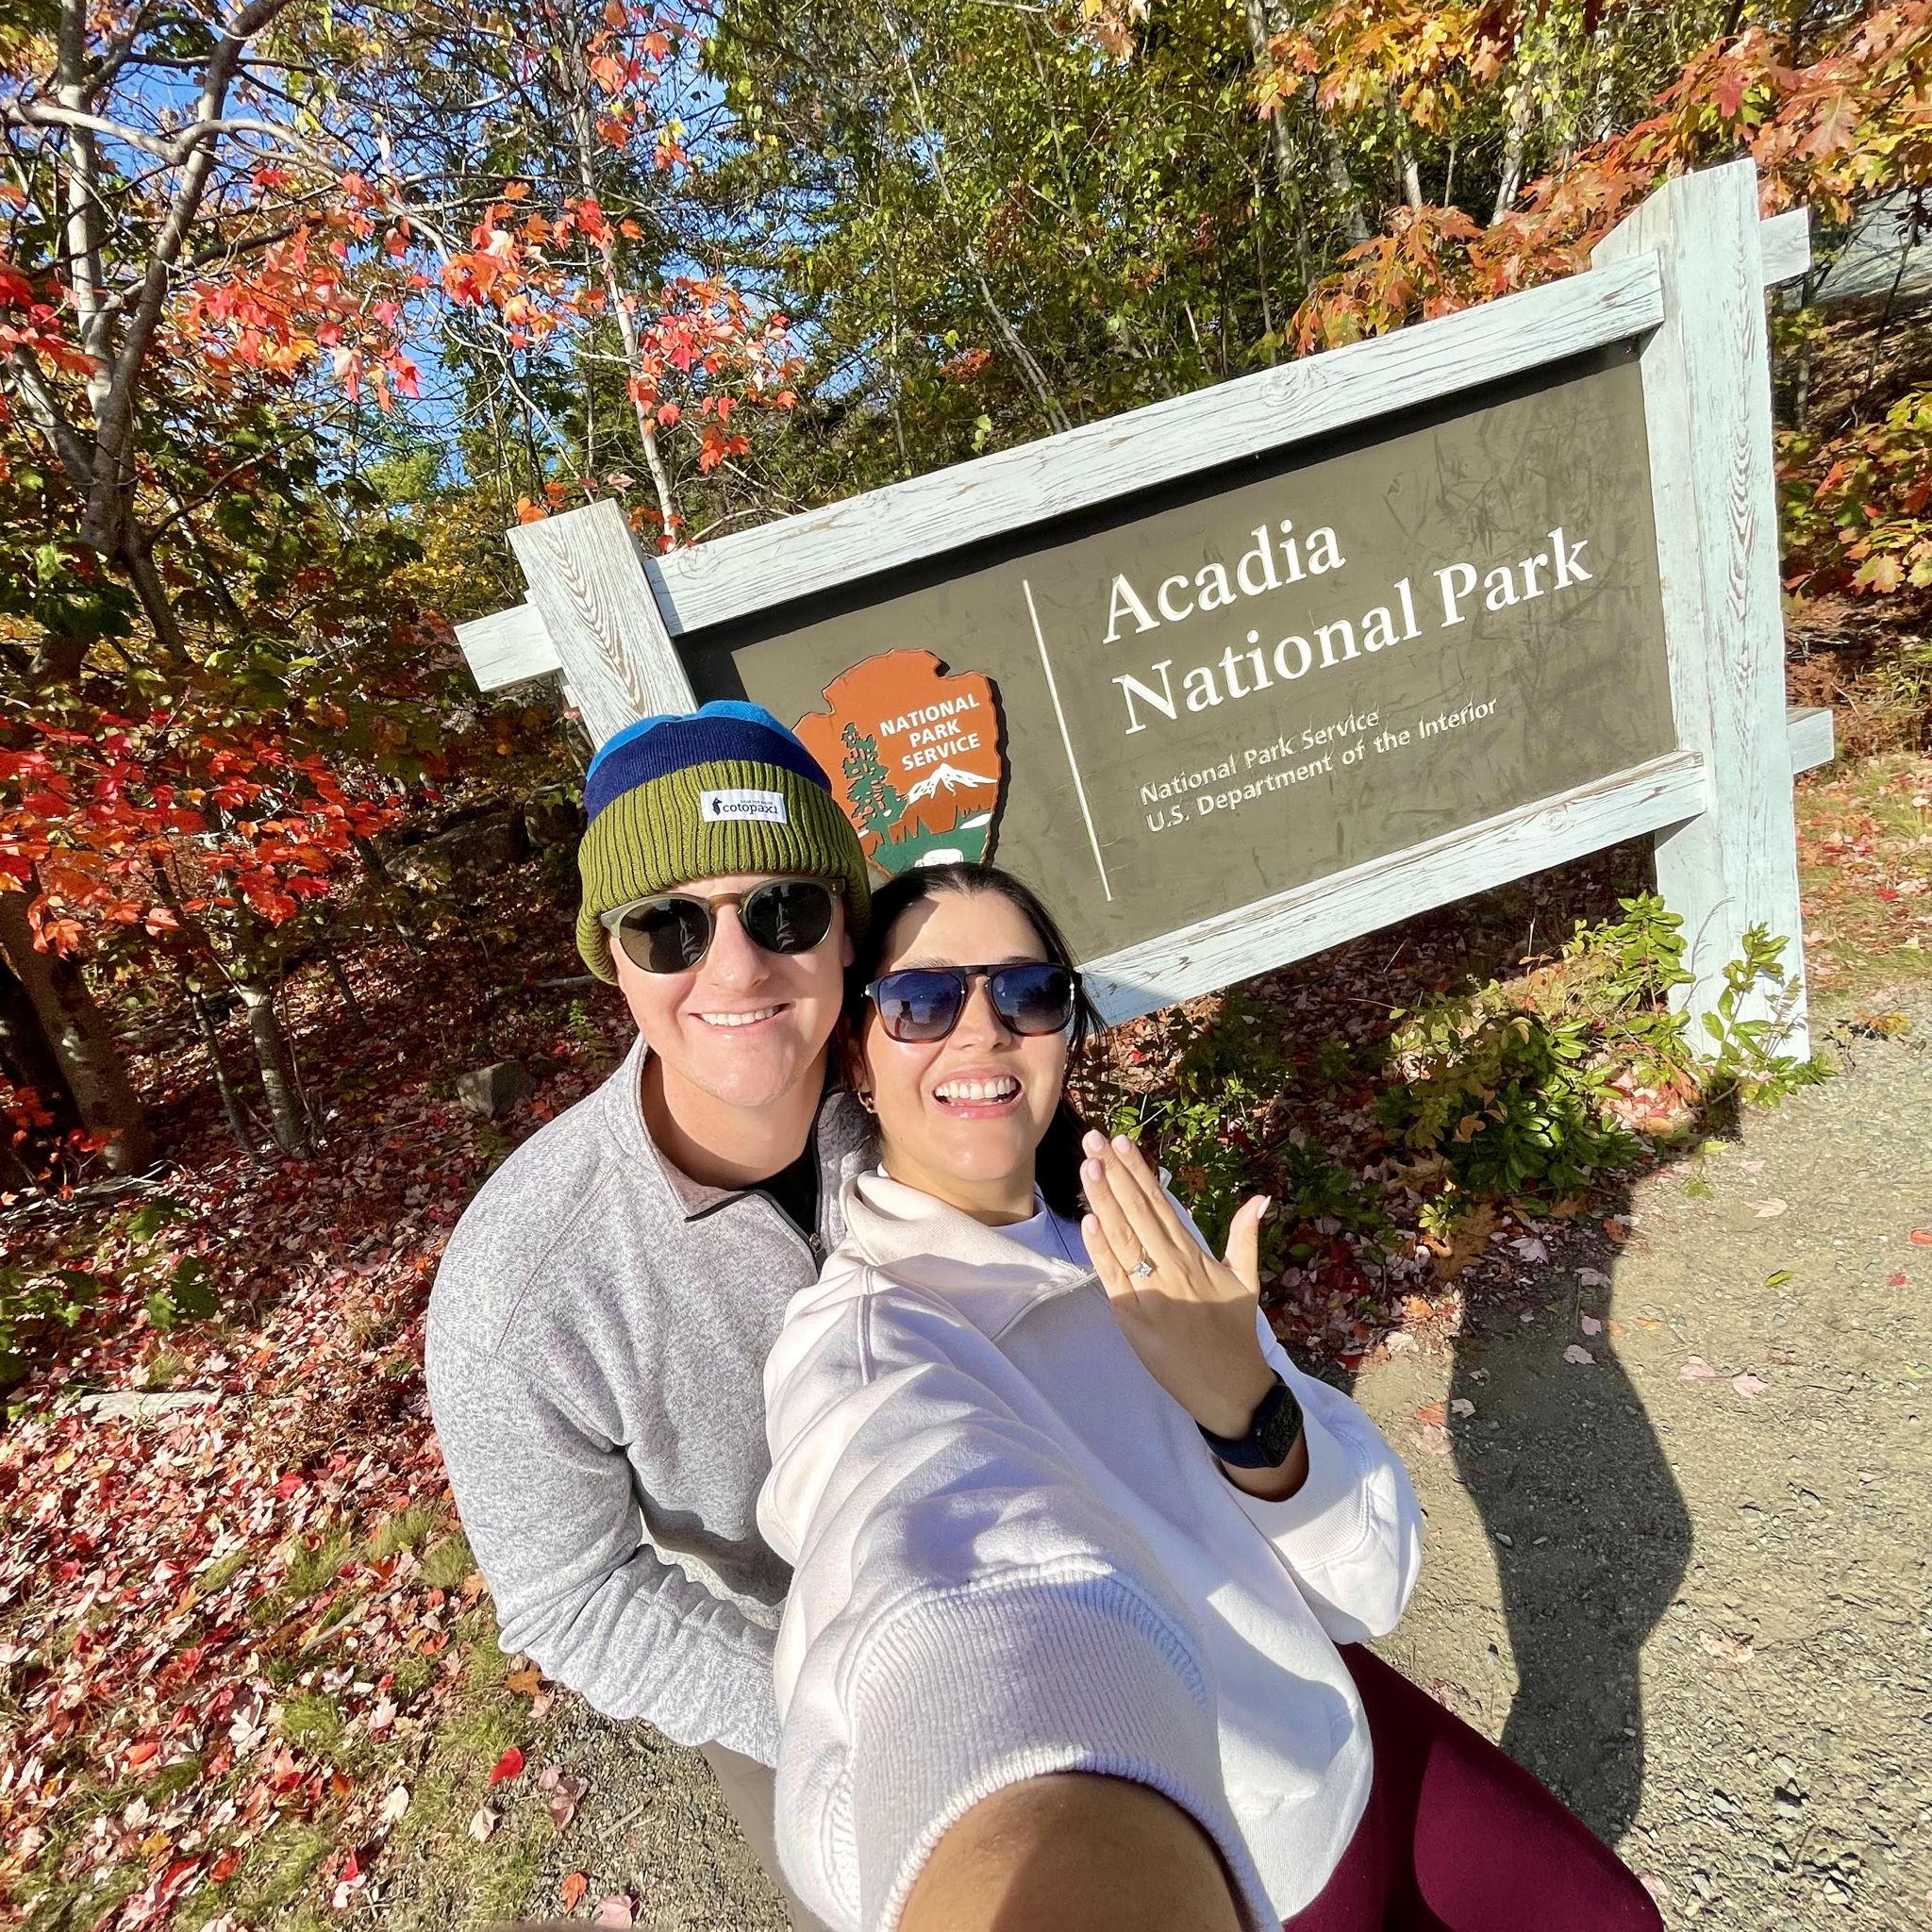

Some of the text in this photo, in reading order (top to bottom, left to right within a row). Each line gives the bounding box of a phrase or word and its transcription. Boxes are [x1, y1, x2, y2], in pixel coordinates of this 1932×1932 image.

[1102, 519, 1346, 643] Acadia
[1111, 526, 1592, 735] National Park
[879, 693, 980, 737] NATIONAL
[908, 718, 961, 748] PARK
[901, 733, 981, 771] SERVICE
[1140, 709, 1379, 805] National Park Service
[1146, 697, 1497, 832] U.S. Department of the Interior
[723, 803, 778, 814] cotopaxi
